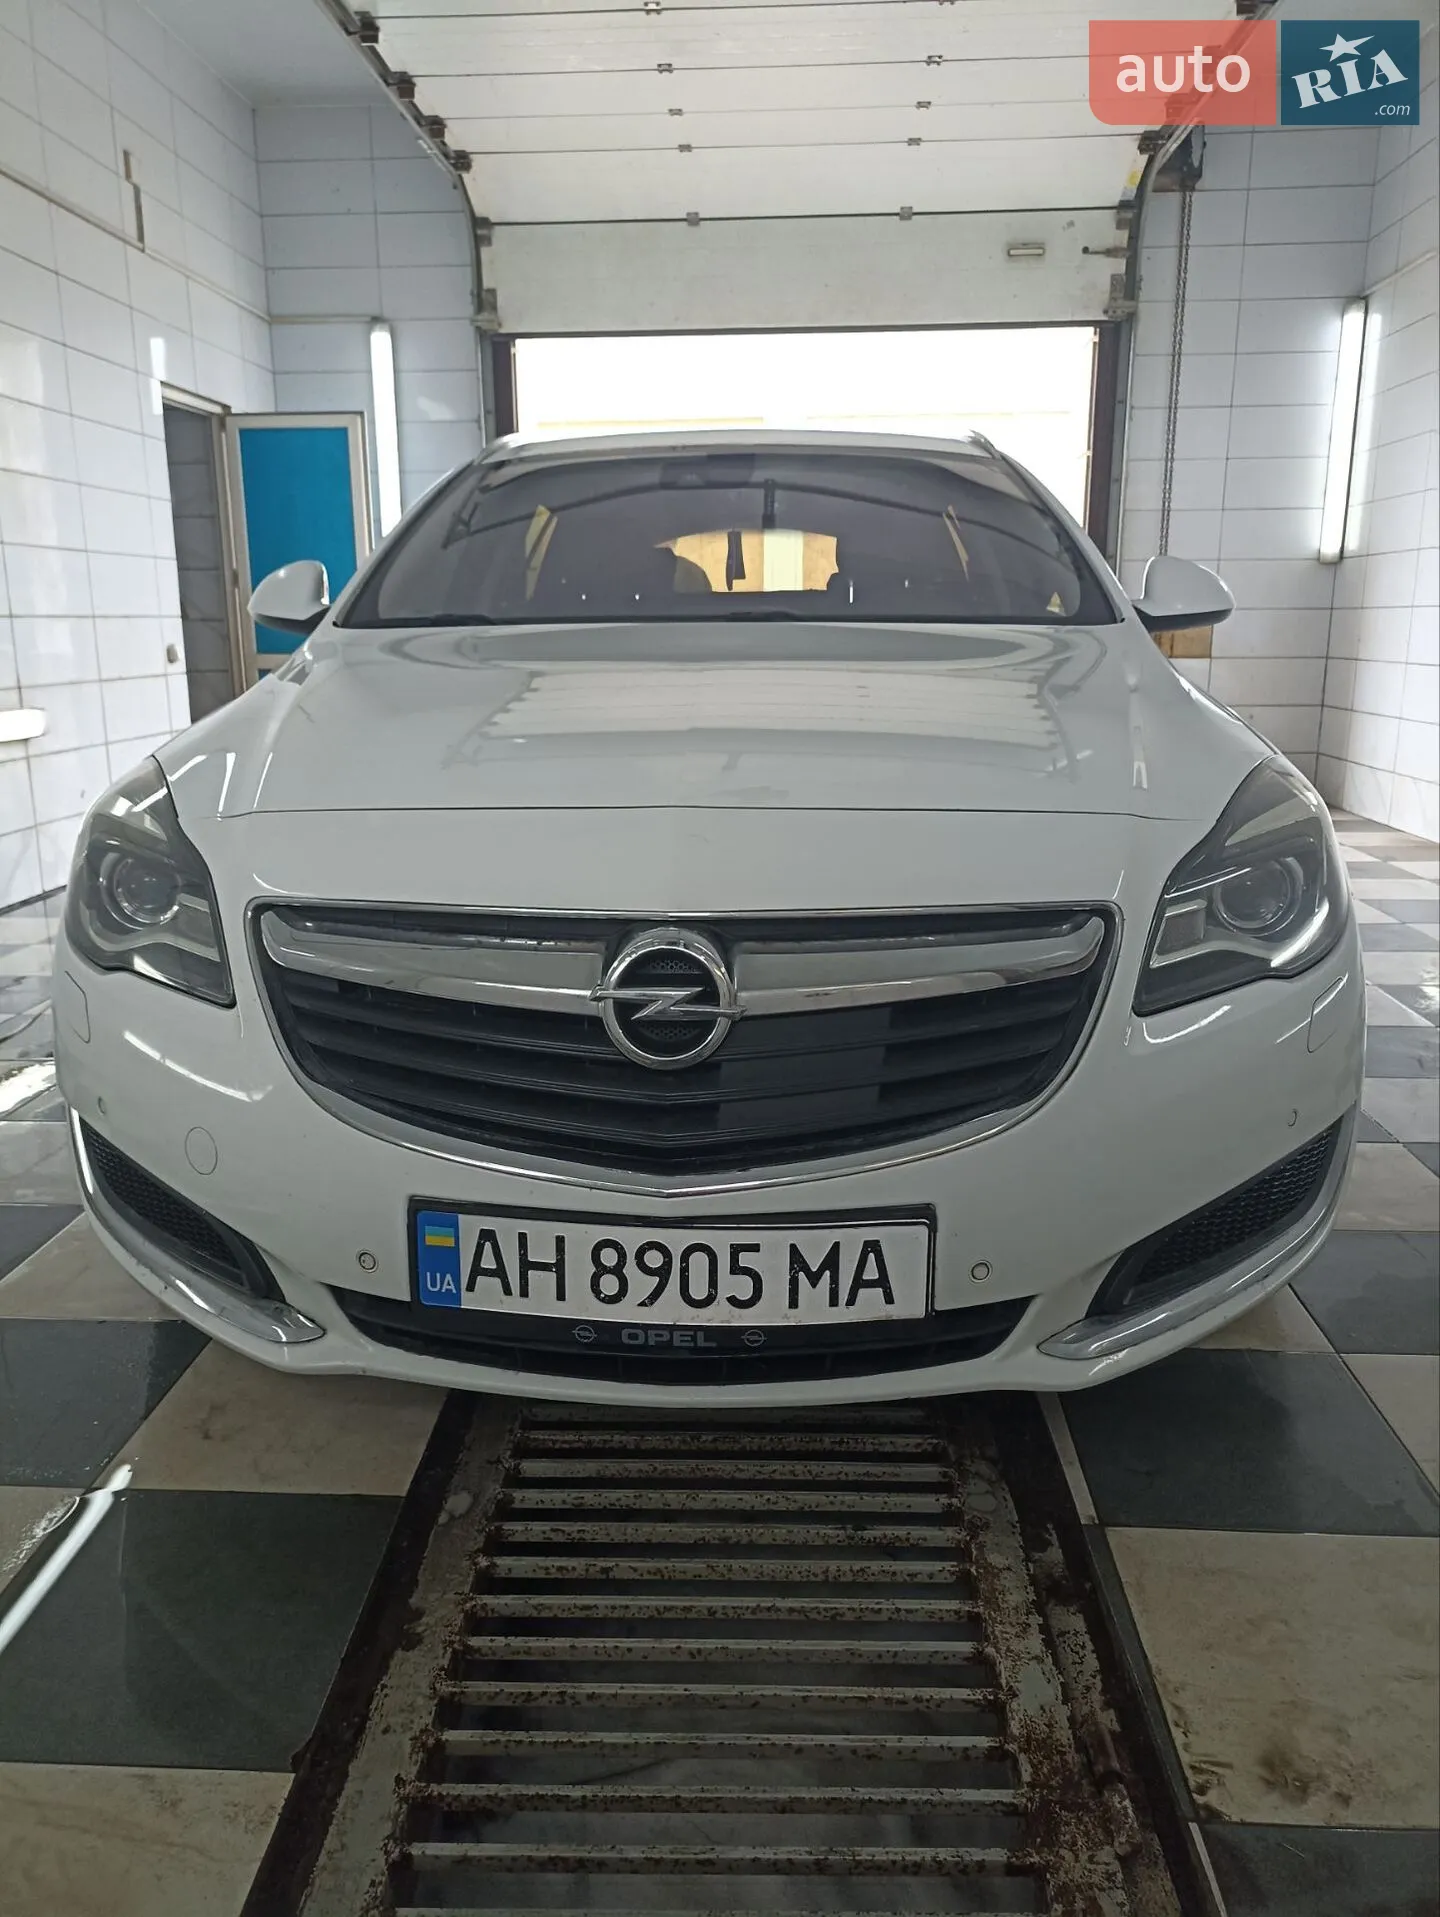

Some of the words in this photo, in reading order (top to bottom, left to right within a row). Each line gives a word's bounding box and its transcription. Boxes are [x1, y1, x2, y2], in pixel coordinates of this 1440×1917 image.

[465, 1228, 567, 1302] AH
[589, 1238, 764, 1310] 8905
[787, 1239, 895, 1310] MA
[426, 1271, 457, 1295] UA
[621, 1328, 718, 1348] OPEL
